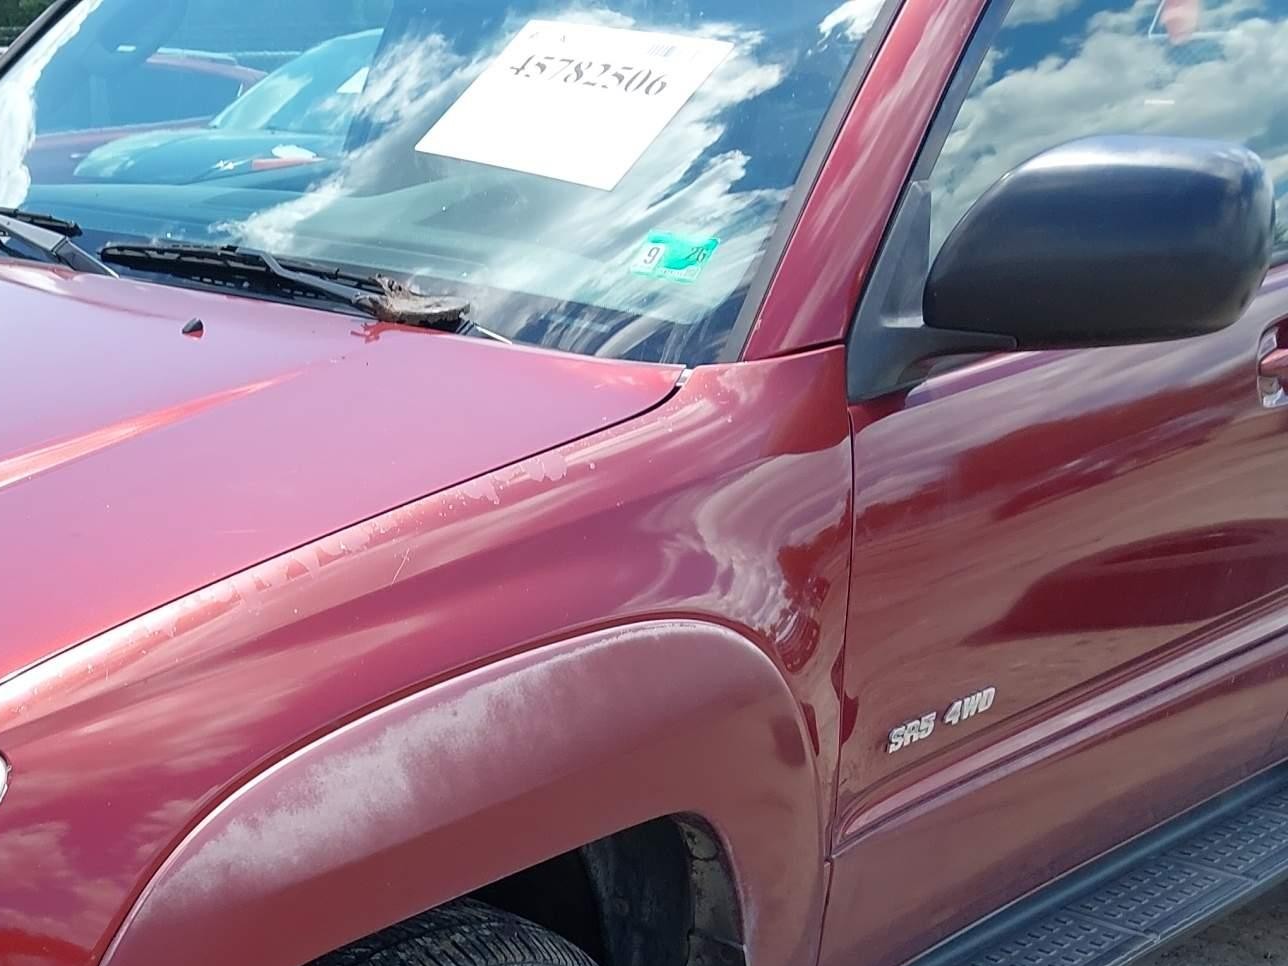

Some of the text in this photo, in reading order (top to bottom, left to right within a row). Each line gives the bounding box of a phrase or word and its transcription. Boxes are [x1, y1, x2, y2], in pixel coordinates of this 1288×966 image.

[510, 54, 668, 95] 45782506
[643, 246, 661, 265] 9
[888, 686, 996, 753] SR5 4WD
